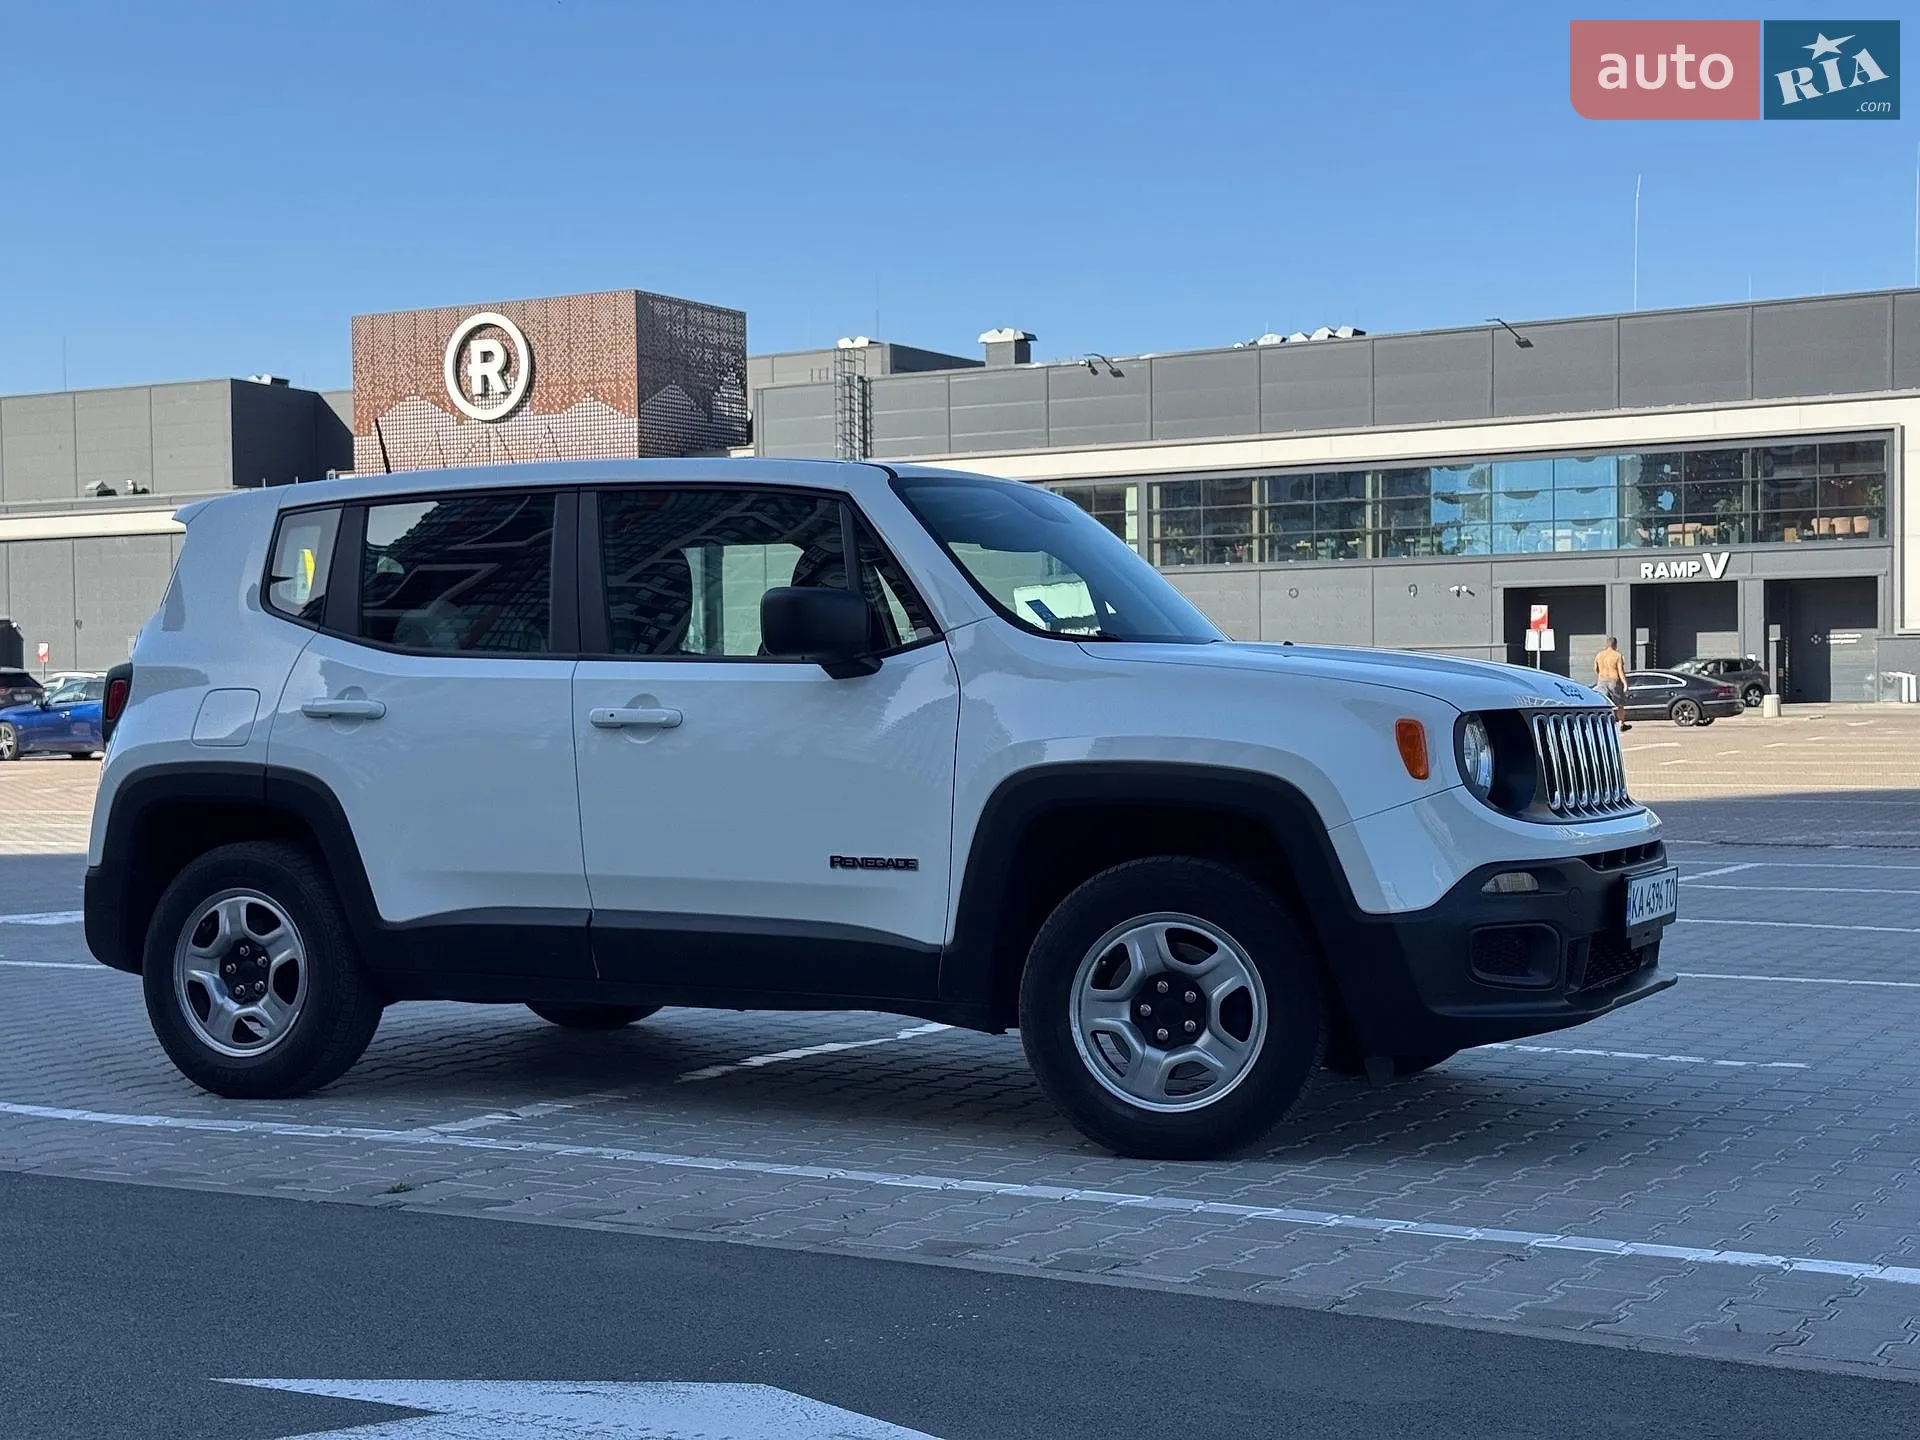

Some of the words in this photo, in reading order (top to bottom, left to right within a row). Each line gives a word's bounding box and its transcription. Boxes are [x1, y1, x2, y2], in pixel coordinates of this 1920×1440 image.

[1640, 561, 1701, 579] RAMP
[1702, 551, 1731, 579] V
[829, 855, 919, 871] RENEGADE
[1632, 885, 1644, 919] KA
